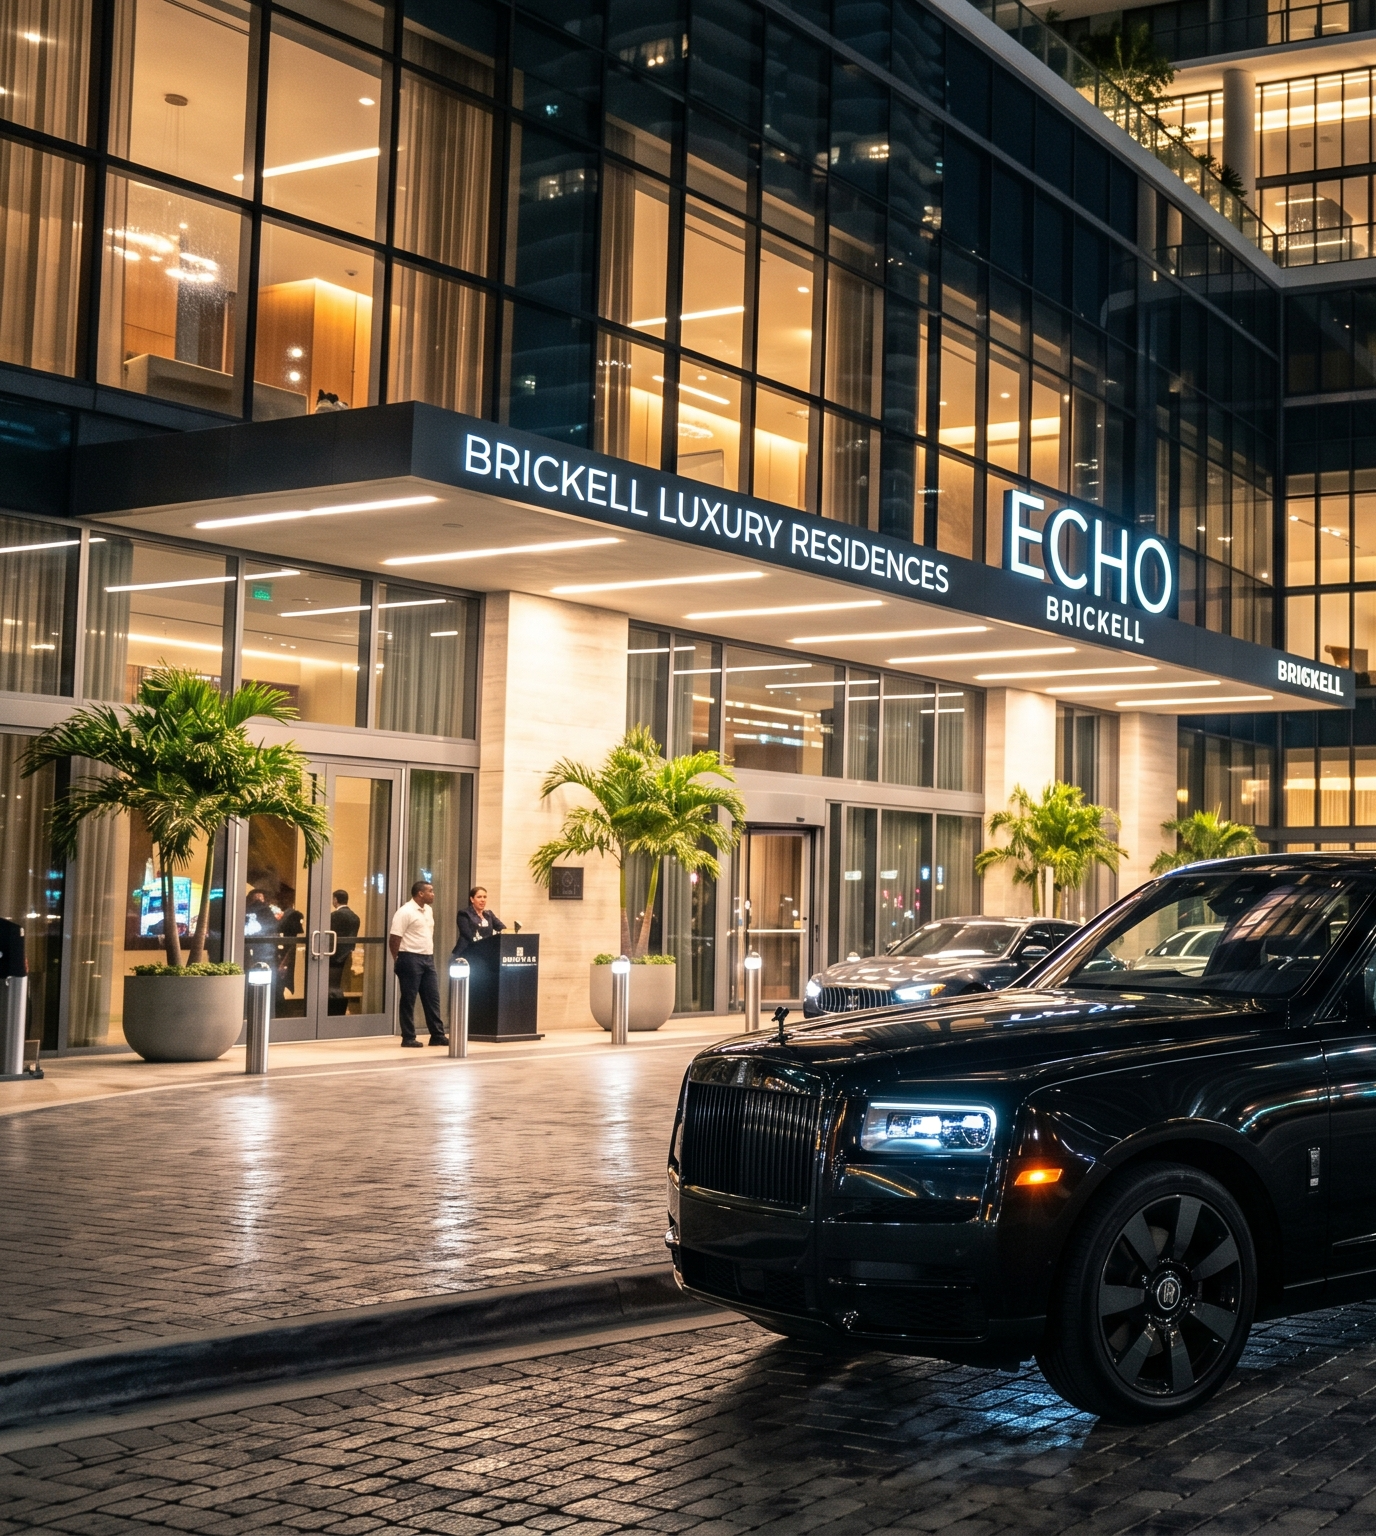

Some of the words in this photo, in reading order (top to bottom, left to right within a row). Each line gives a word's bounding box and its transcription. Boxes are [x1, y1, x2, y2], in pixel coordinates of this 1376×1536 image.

[465, 433, 649, 517] BRICKELL
[659, 486, 783, 549] LUXURY
[791, 522, 949, 593] RESIDENCES
[1010, 489, 1172, 614] ECHO
[1046, 595, 1145, 645] BRICKELL
